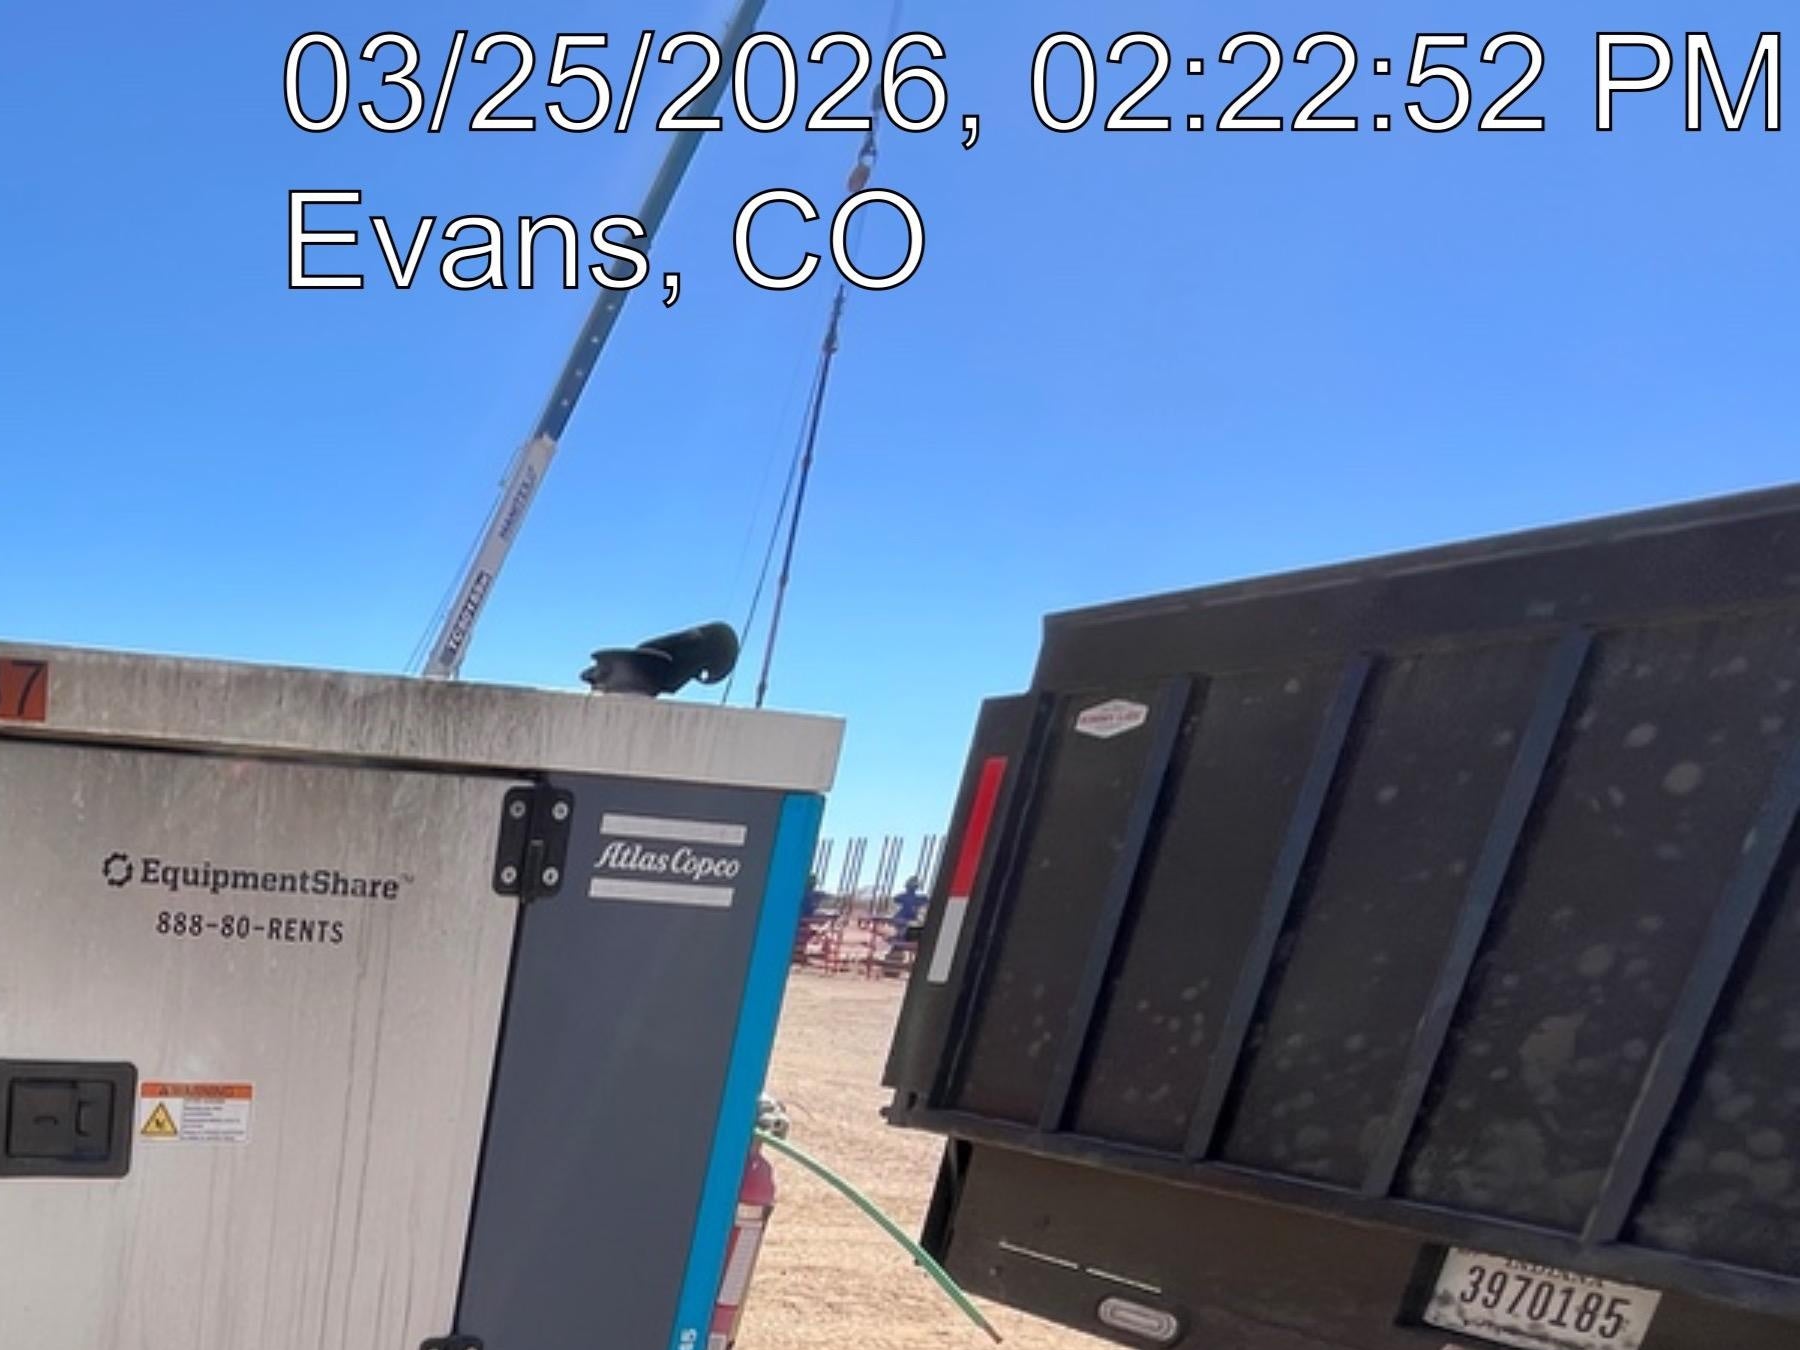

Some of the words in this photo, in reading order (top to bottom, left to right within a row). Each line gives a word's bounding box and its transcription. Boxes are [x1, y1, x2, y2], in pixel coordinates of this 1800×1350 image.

[594, 840, 669, 874] Atlas
[670, 846, 742, 881] Copco
[155, 910, 345, 944] 888-80-RENTS
[1460, 1264, 1632, 1339] 3970185
